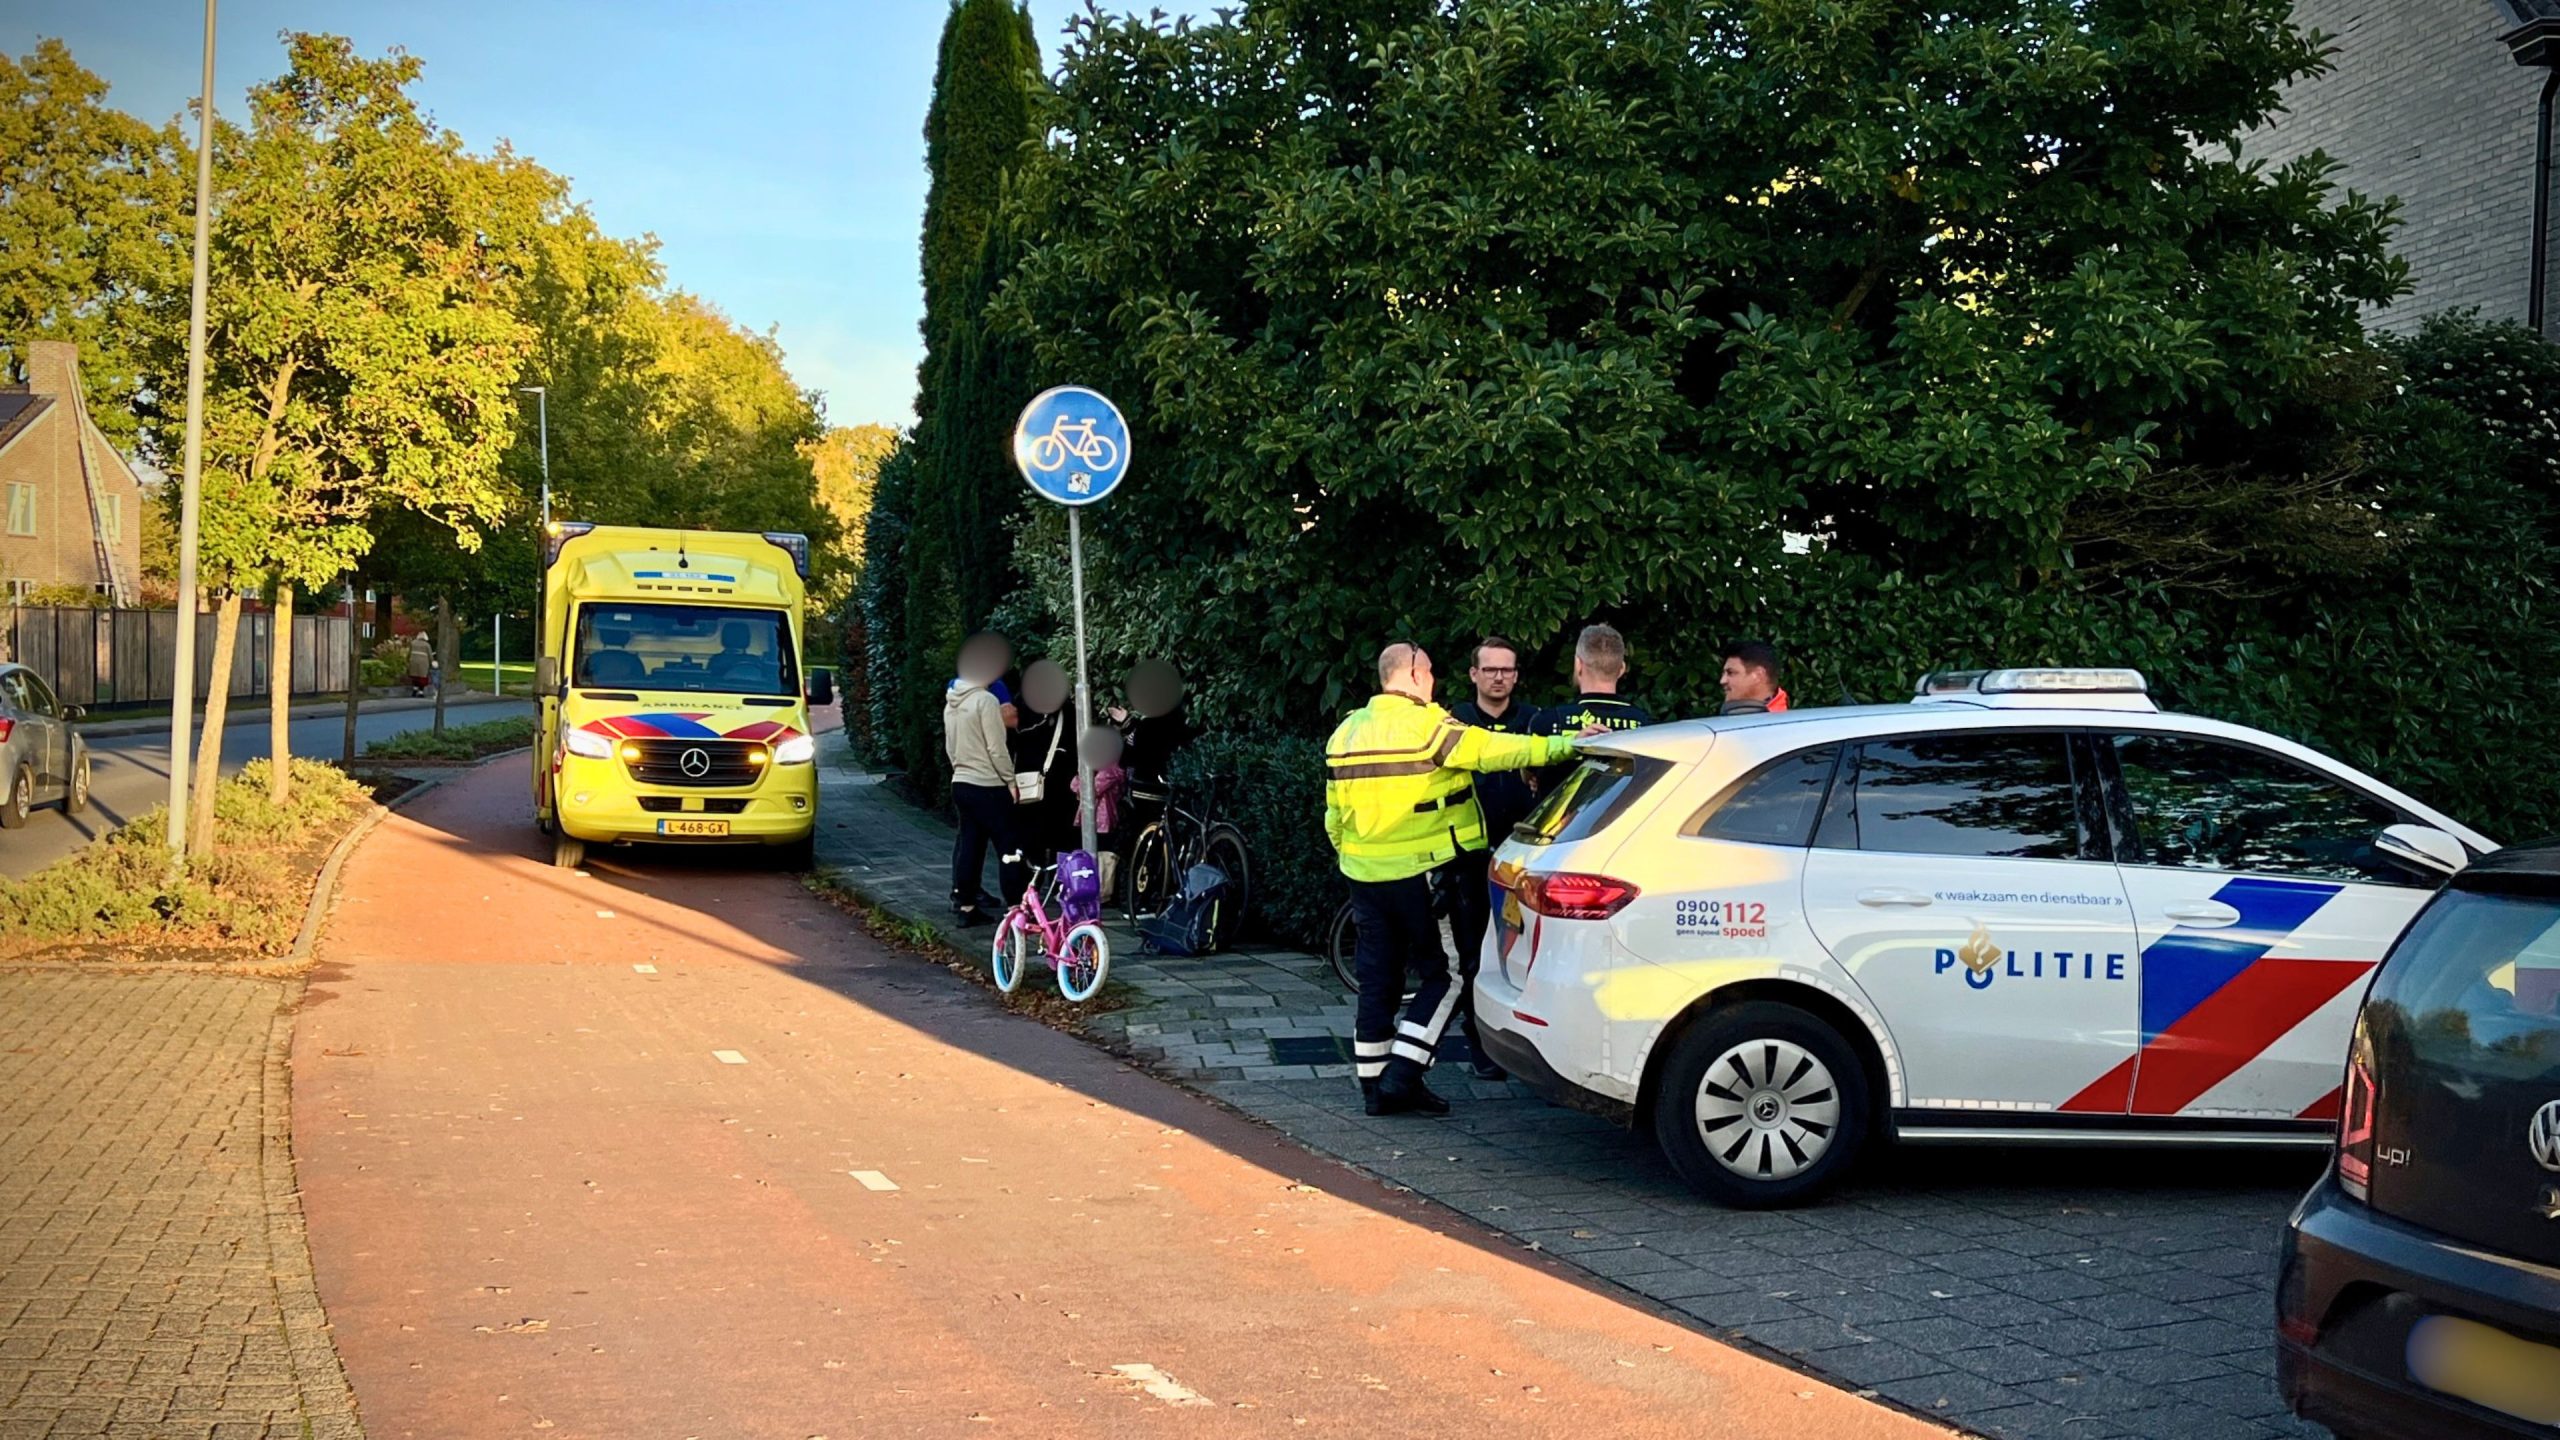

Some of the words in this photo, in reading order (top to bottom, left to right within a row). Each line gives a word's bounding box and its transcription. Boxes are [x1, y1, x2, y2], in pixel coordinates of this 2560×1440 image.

[642, 702, 742, 711] AMBULANCE
[1571, 713, 1638, 730] PLITIE
[668, 822, 724, 834] L-468-GX
[1945, 890, 2017, 902] waakzaam
[2020, 893, 2037, 903] en
[2039, 891, 2111, 906] dienstbaar
[1676, 900, 1720, 913] 0900
[1723, 902, 1765, 924] 112
[1676, 914, 1720, 927] 8844
[1723, 926, 1765, 939] spoed
[2377, 1143, 2411, 1167] up!
